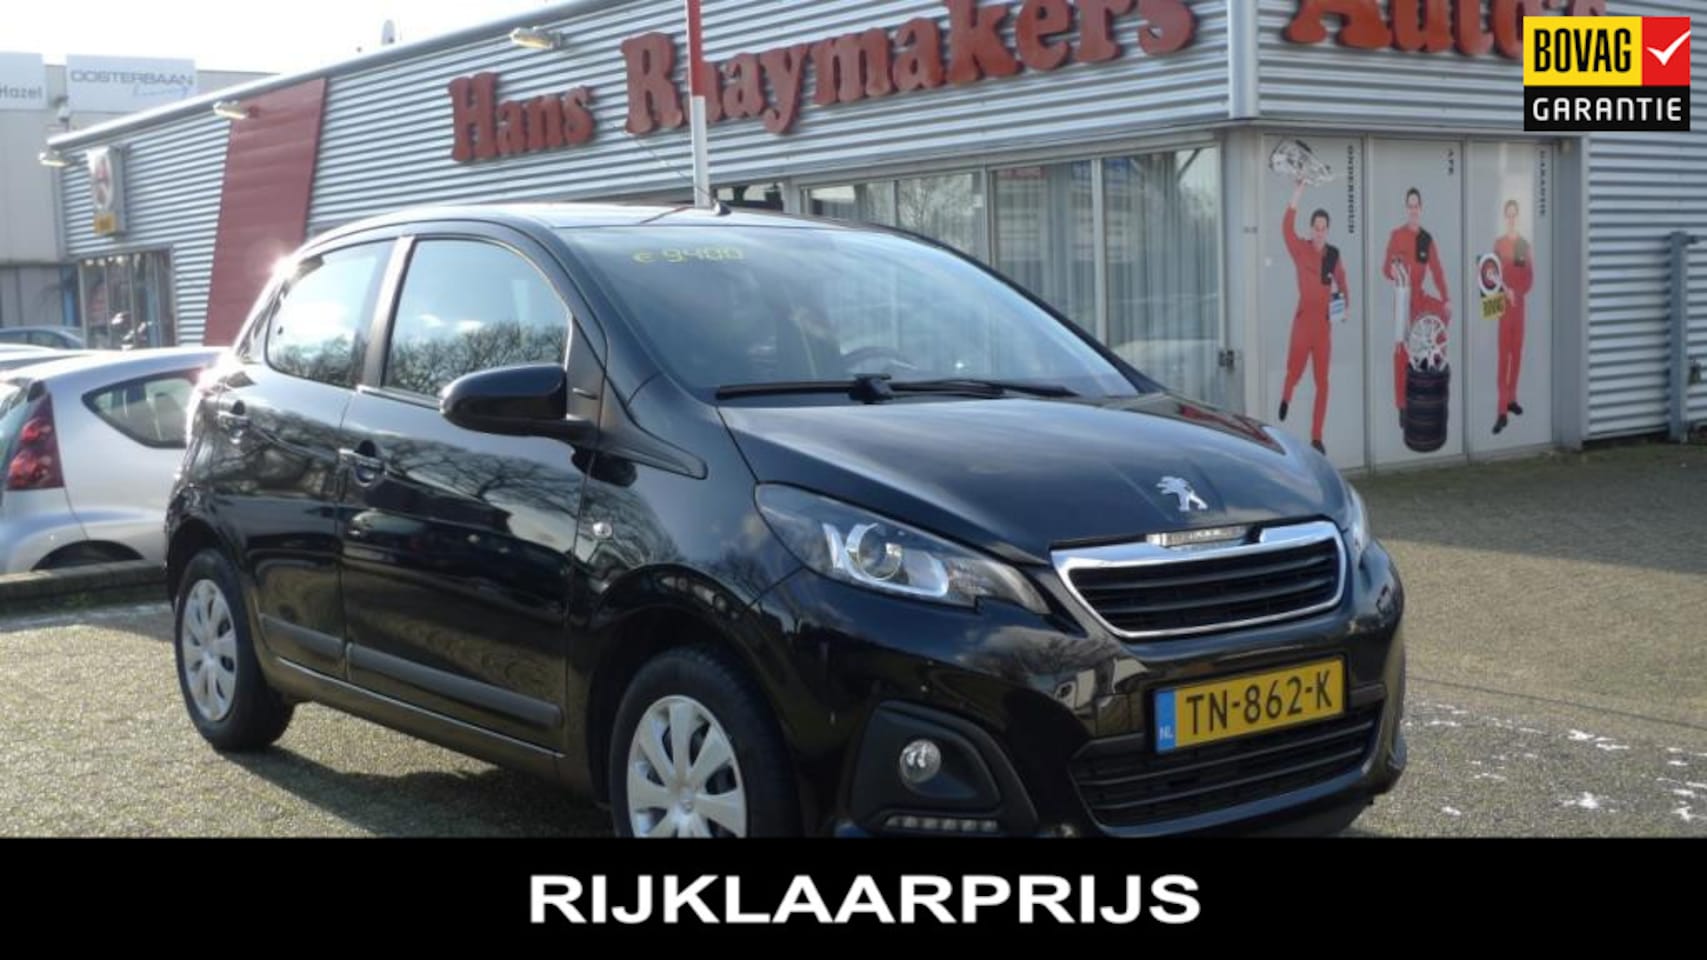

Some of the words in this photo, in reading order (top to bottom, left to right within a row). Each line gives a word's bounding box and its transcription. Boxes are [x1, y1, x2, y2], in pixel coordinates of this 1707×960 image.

[70, 69, 194, 86] OOSTERBAAN
[448, 71, 595, 162] Hans
[1186, 671, 1332, 734] TN-862-K
